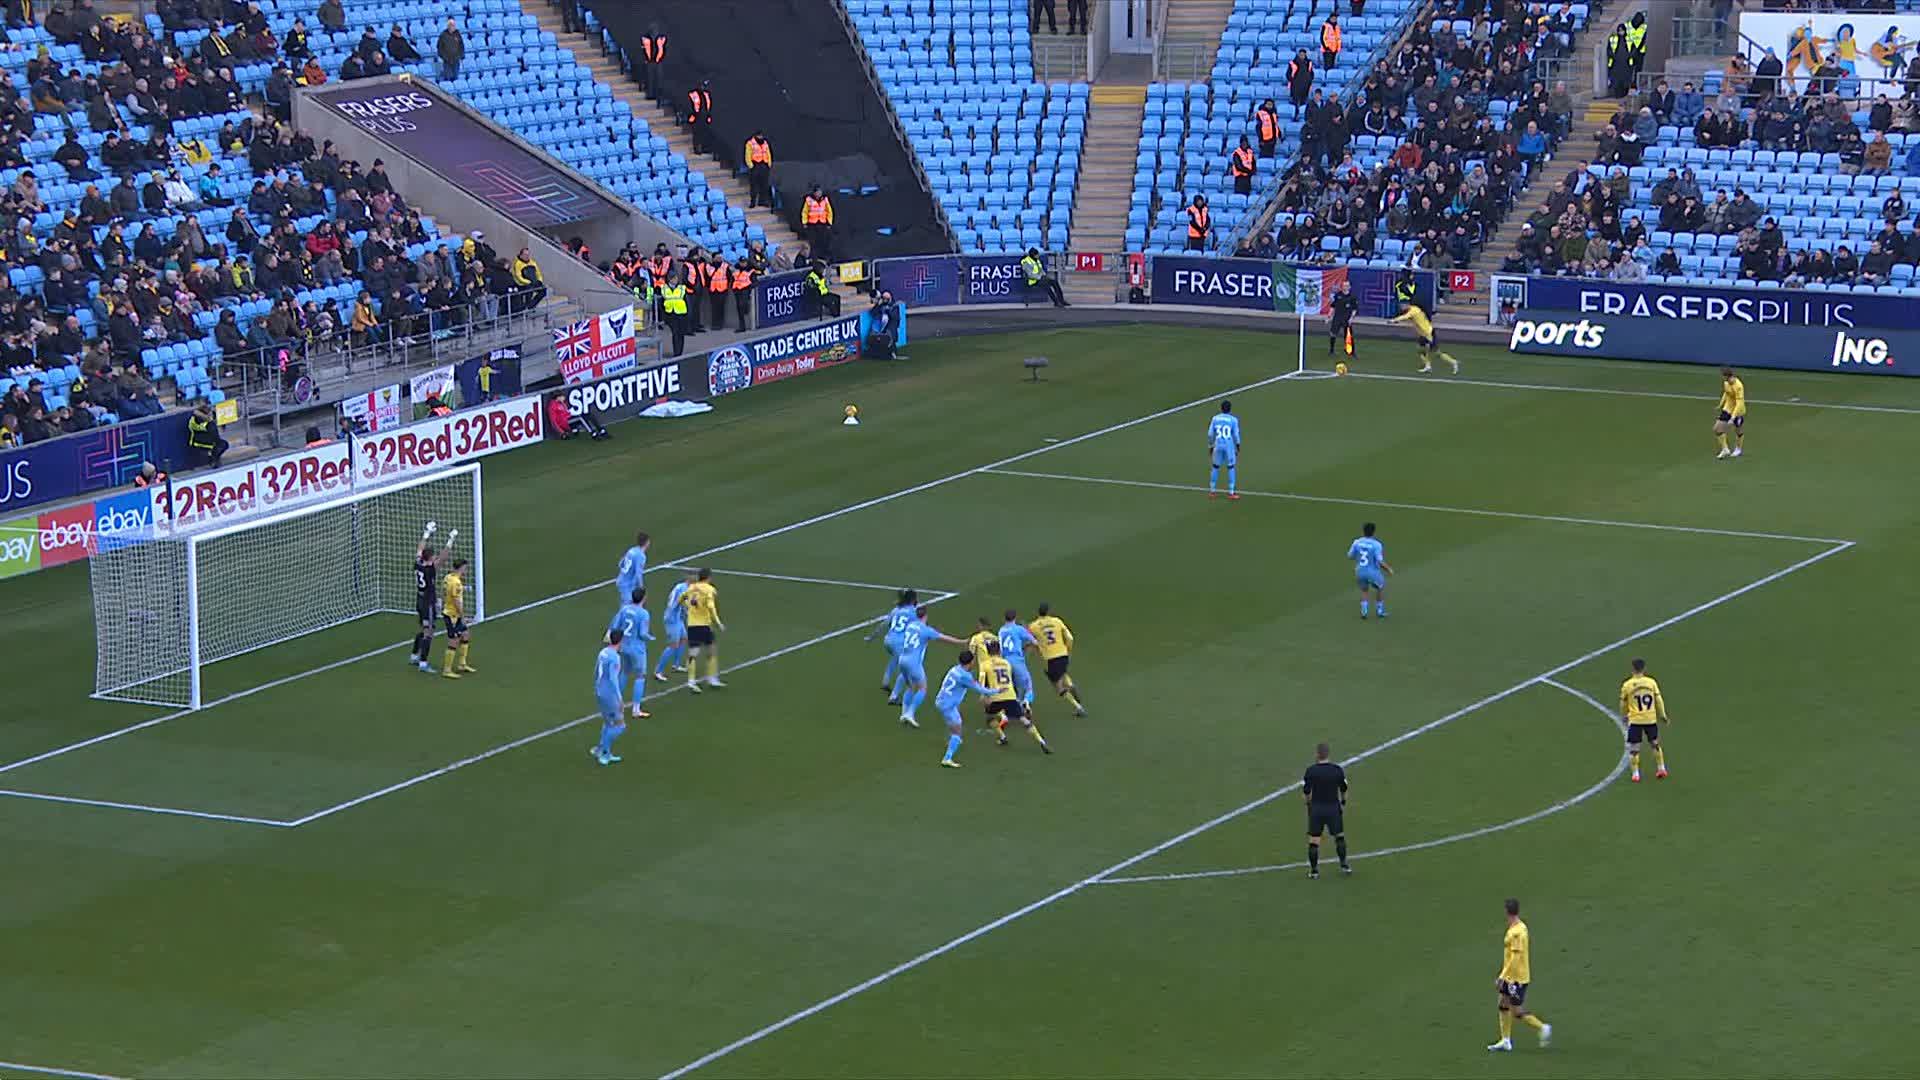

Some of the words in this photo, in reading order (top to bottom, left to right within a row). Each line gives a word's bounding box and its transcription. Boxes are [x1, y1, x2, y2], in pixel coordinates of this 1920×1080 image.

[336, 92, 432, 118] FRASERS
[360, 116, 417, 133] PLUS
[1081, 256, 1097, 268] P1
[970, 281, 1010, 295] PLUS
[1454, 275, 1470, 287] P2
[767, 300, 793, 318] PLUS
[754, 336, 793, 361] TRADE
[796, 324, 839, 351] CENTRE
[842, 319, 858, 339] UK
[1510, 320, 1605, 350] ports
[564, 355, 591, 375] LLOYD
[591, 343, 628, 364] CALCUTT
[795, 356, 815, 369] Today
[569, 364, 680, 416] SPORTFIVE
[362, 423, 452, 479] 32Red
[455, 402, 540, 455] 32Red
[1214, 424, 1232, 439] 30
[98, 505, 148, 537] ebay
[40, 519, 93, 551] ebay
[1358, 550, 1369, 566] 3
[623, 619, 634, 637] 2
[994, 668, 1010, 685] 15
[1633, 693, 1653, 711] 19
